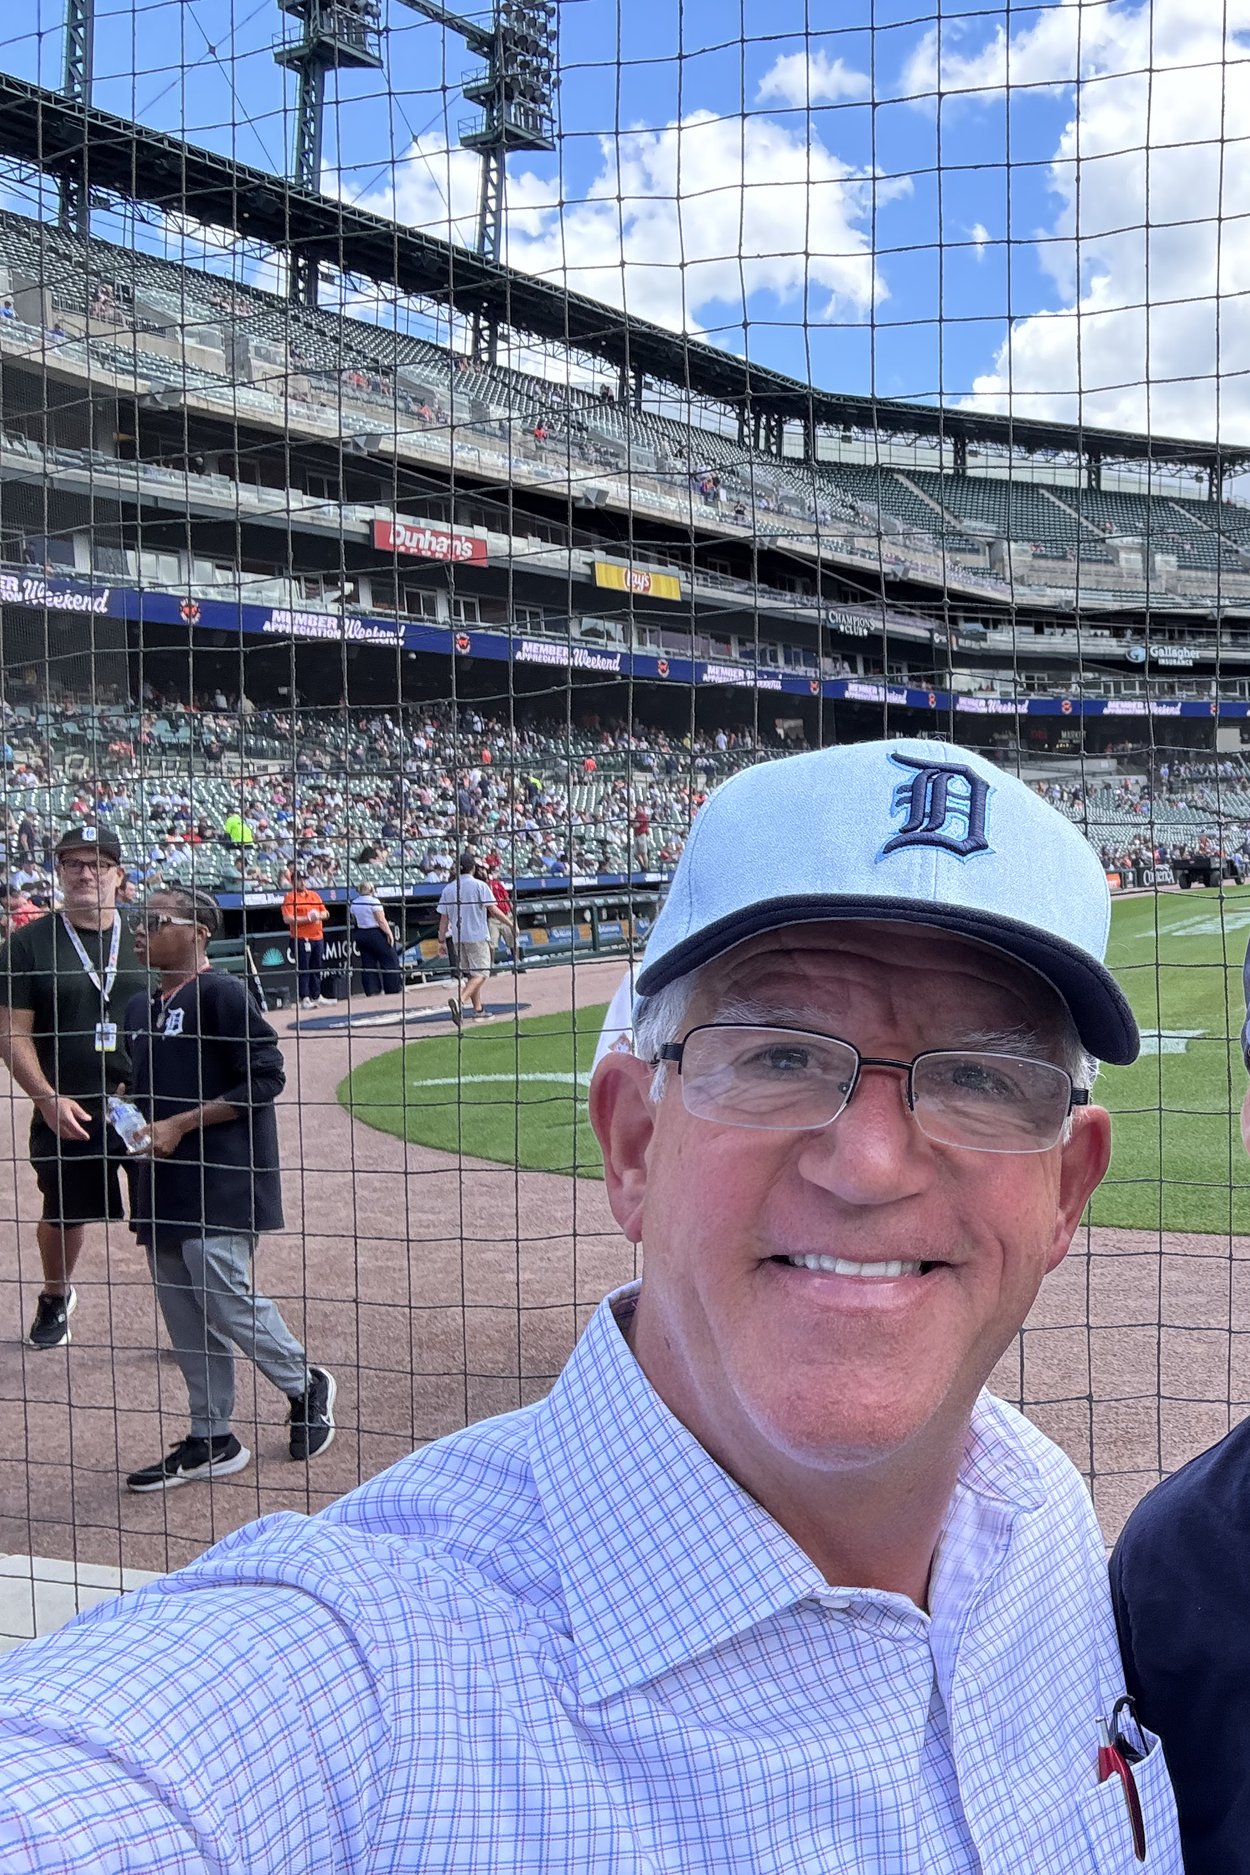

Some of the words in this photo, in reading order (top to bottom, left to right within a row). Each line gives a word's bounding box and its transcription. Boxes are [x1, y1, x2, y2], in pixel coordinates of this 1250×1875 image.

[389, 523, 473, 558] Dunham's
[23, 578, 110, 614] Weekend
[272, 609, 339, 629] MEMBER
[828, 610, 876, 631] CHAMPIONS
[844, 625, 863, 637] CLUB
[522, 641, 569, 657] MEMBER
[572, 648, 621, 671] Weekend
[1150, 646, 1201, 659] Gallagher
